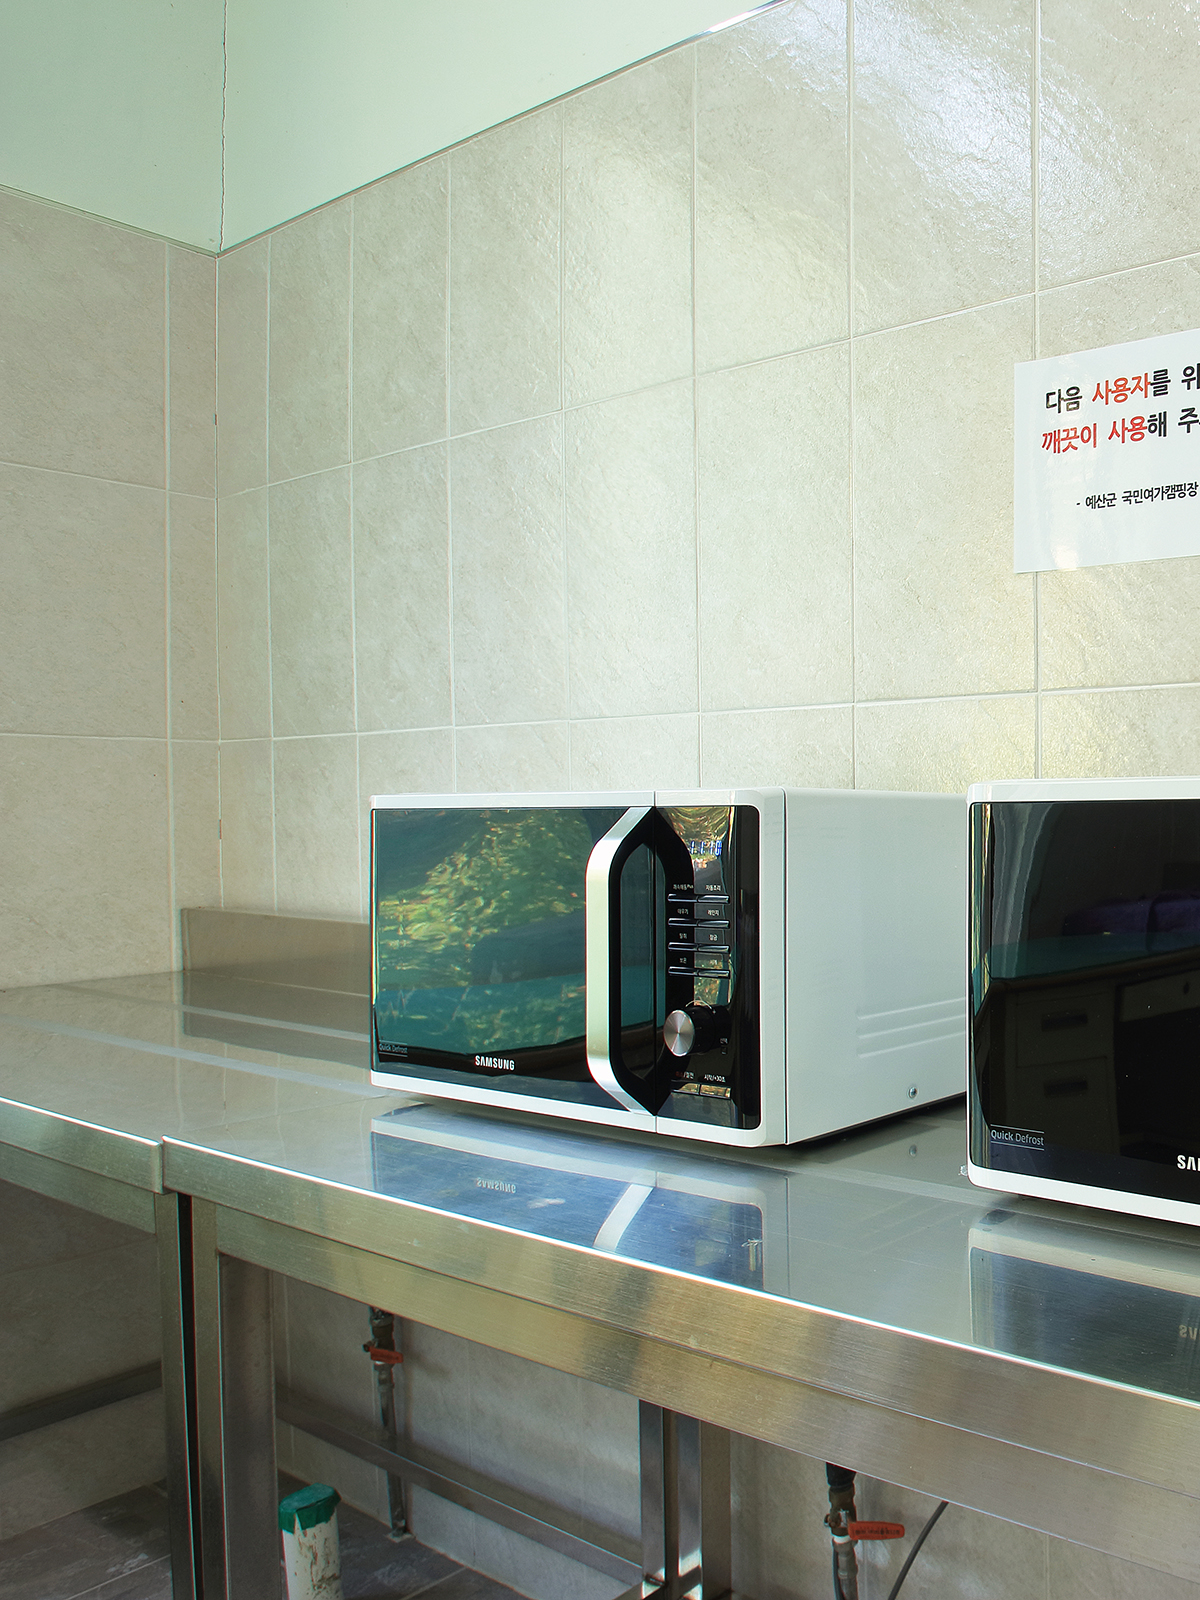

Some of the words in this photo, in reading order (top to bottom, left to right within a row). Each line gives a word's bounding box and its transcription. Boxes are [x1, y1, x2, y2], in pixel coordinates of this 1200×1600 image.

[1045, 385, 1083, 413] 다음
[1092, 368, 1171, 405] 사용자를
[1041, 423, 1097, 454] 깨끗이
[1108, 411, 1168, 443] 사용해
[1085, 492, 1117, 509] 예산군
[1121, 481, 1199, 505] 국민여가캠핑장
[474, 1055, 515, 1071] SAMSUNG
[990, 1129, 1014, 1141] Quick
[1015, 1132, 1044, 1146] Defrost
